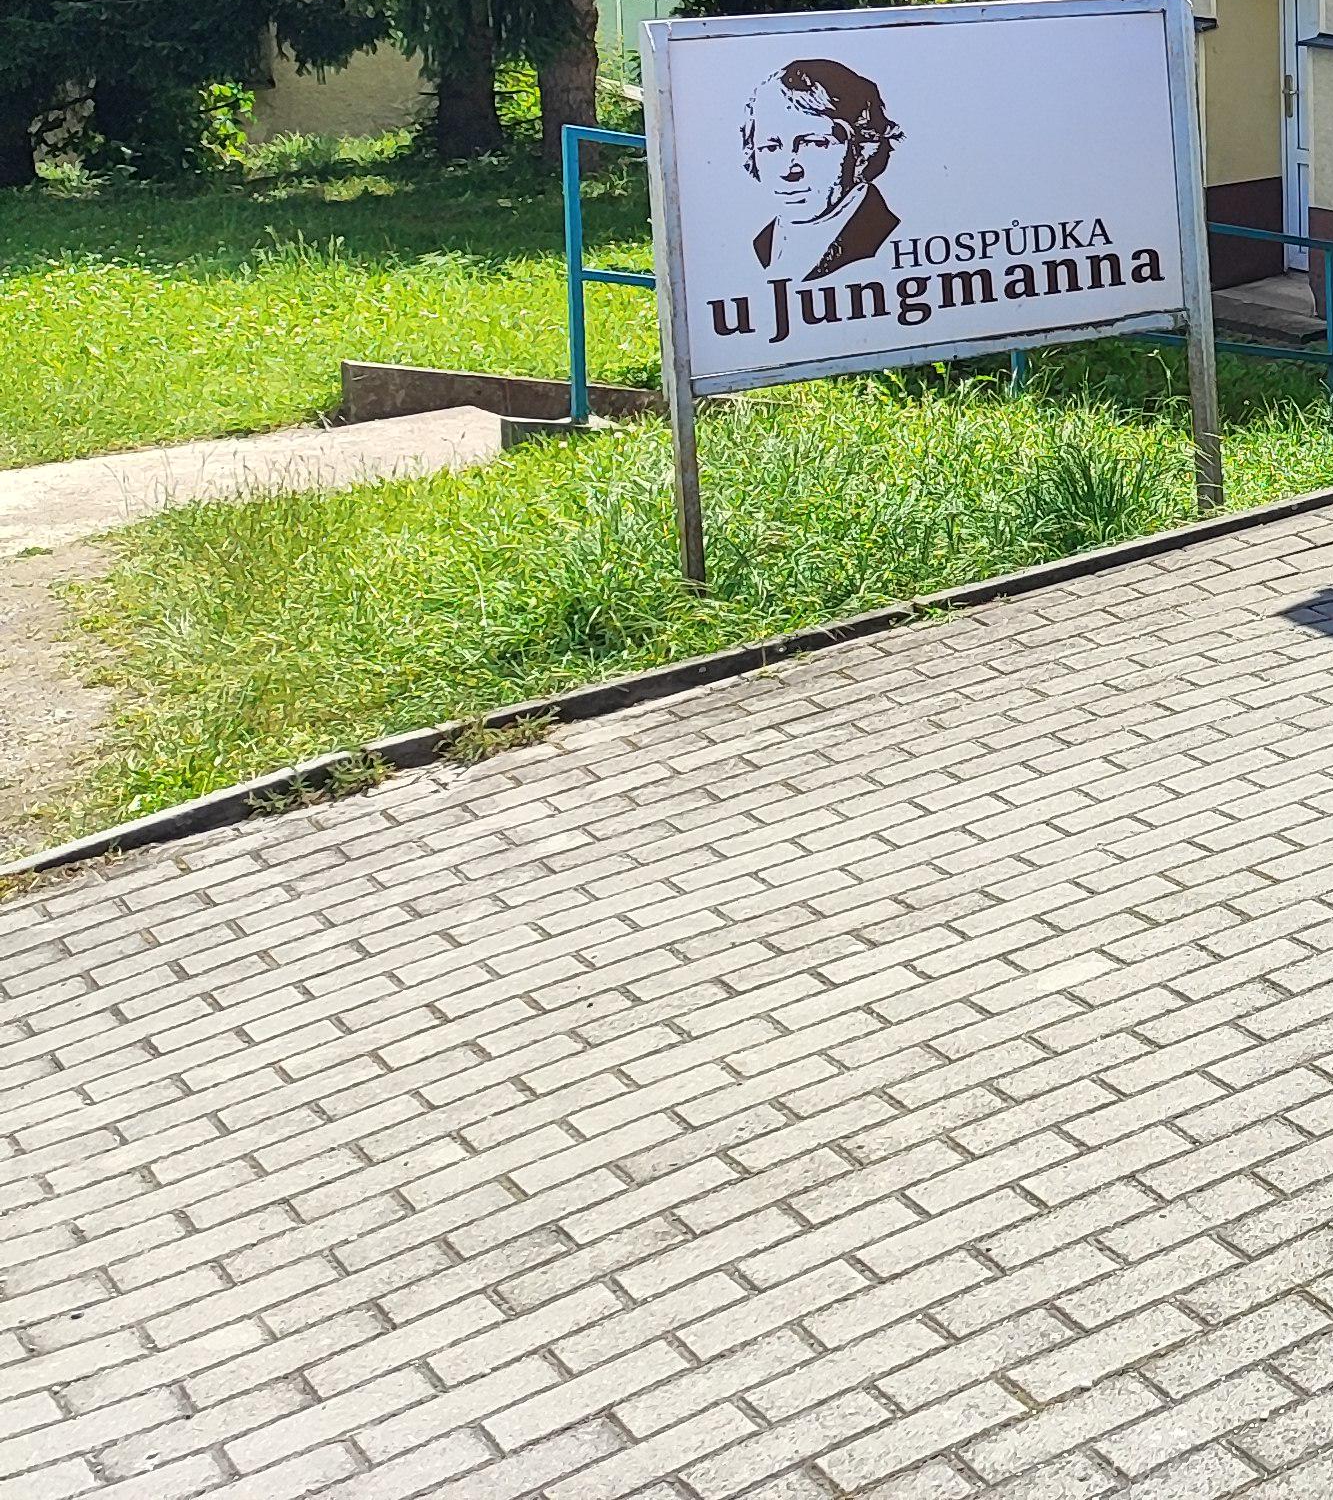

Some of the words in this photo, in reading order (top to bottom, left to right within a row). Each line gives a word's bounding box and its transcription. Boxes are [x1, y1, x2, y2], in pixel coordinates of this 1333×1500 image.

[890, 219, 1114, 270] HOSPŮDKA
[707, 296, 756, 337] u
[766, 246, 1166, 344] Jungmanna
